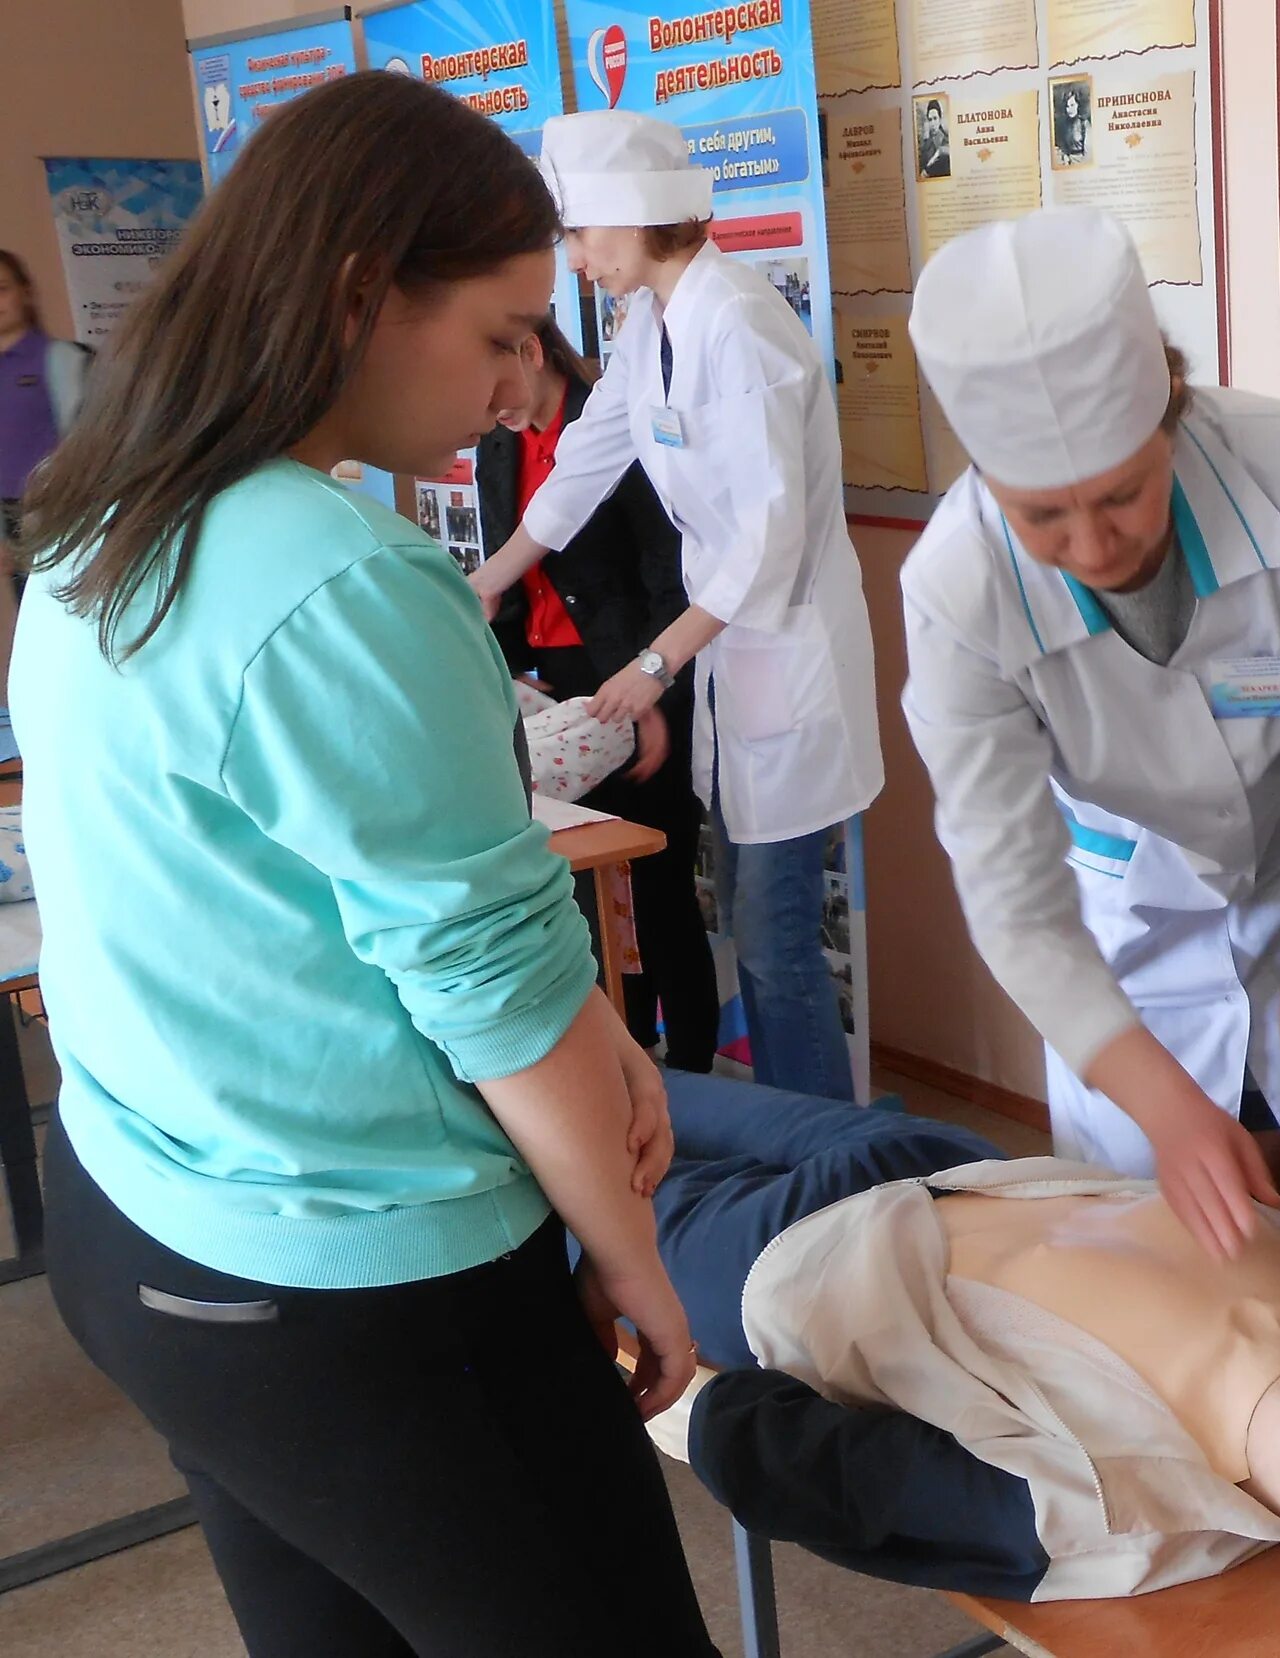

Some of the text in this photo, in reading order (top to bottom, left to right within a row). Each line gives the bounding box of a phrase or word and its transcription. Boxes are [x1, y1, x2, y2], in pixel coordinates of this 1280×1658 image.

[649, 0, 783, 52] Волонтерская
[421, 39, 528, 82] Волонтерская
[655, 48, 783, 105] деятельность
[1097, 89, 1172, 108] ПРИПИСНОВА
[956, 108, 1014, 125] ПЛАТОНОВА
[1108, 119, 1163, 132] Николаевна
[1111, 108, 1159, 120] Анастасия
[699, 130, 726, 153] себя
[727, 126, 776, 154] другим,
[723, 158, 780, 181] богатым»
